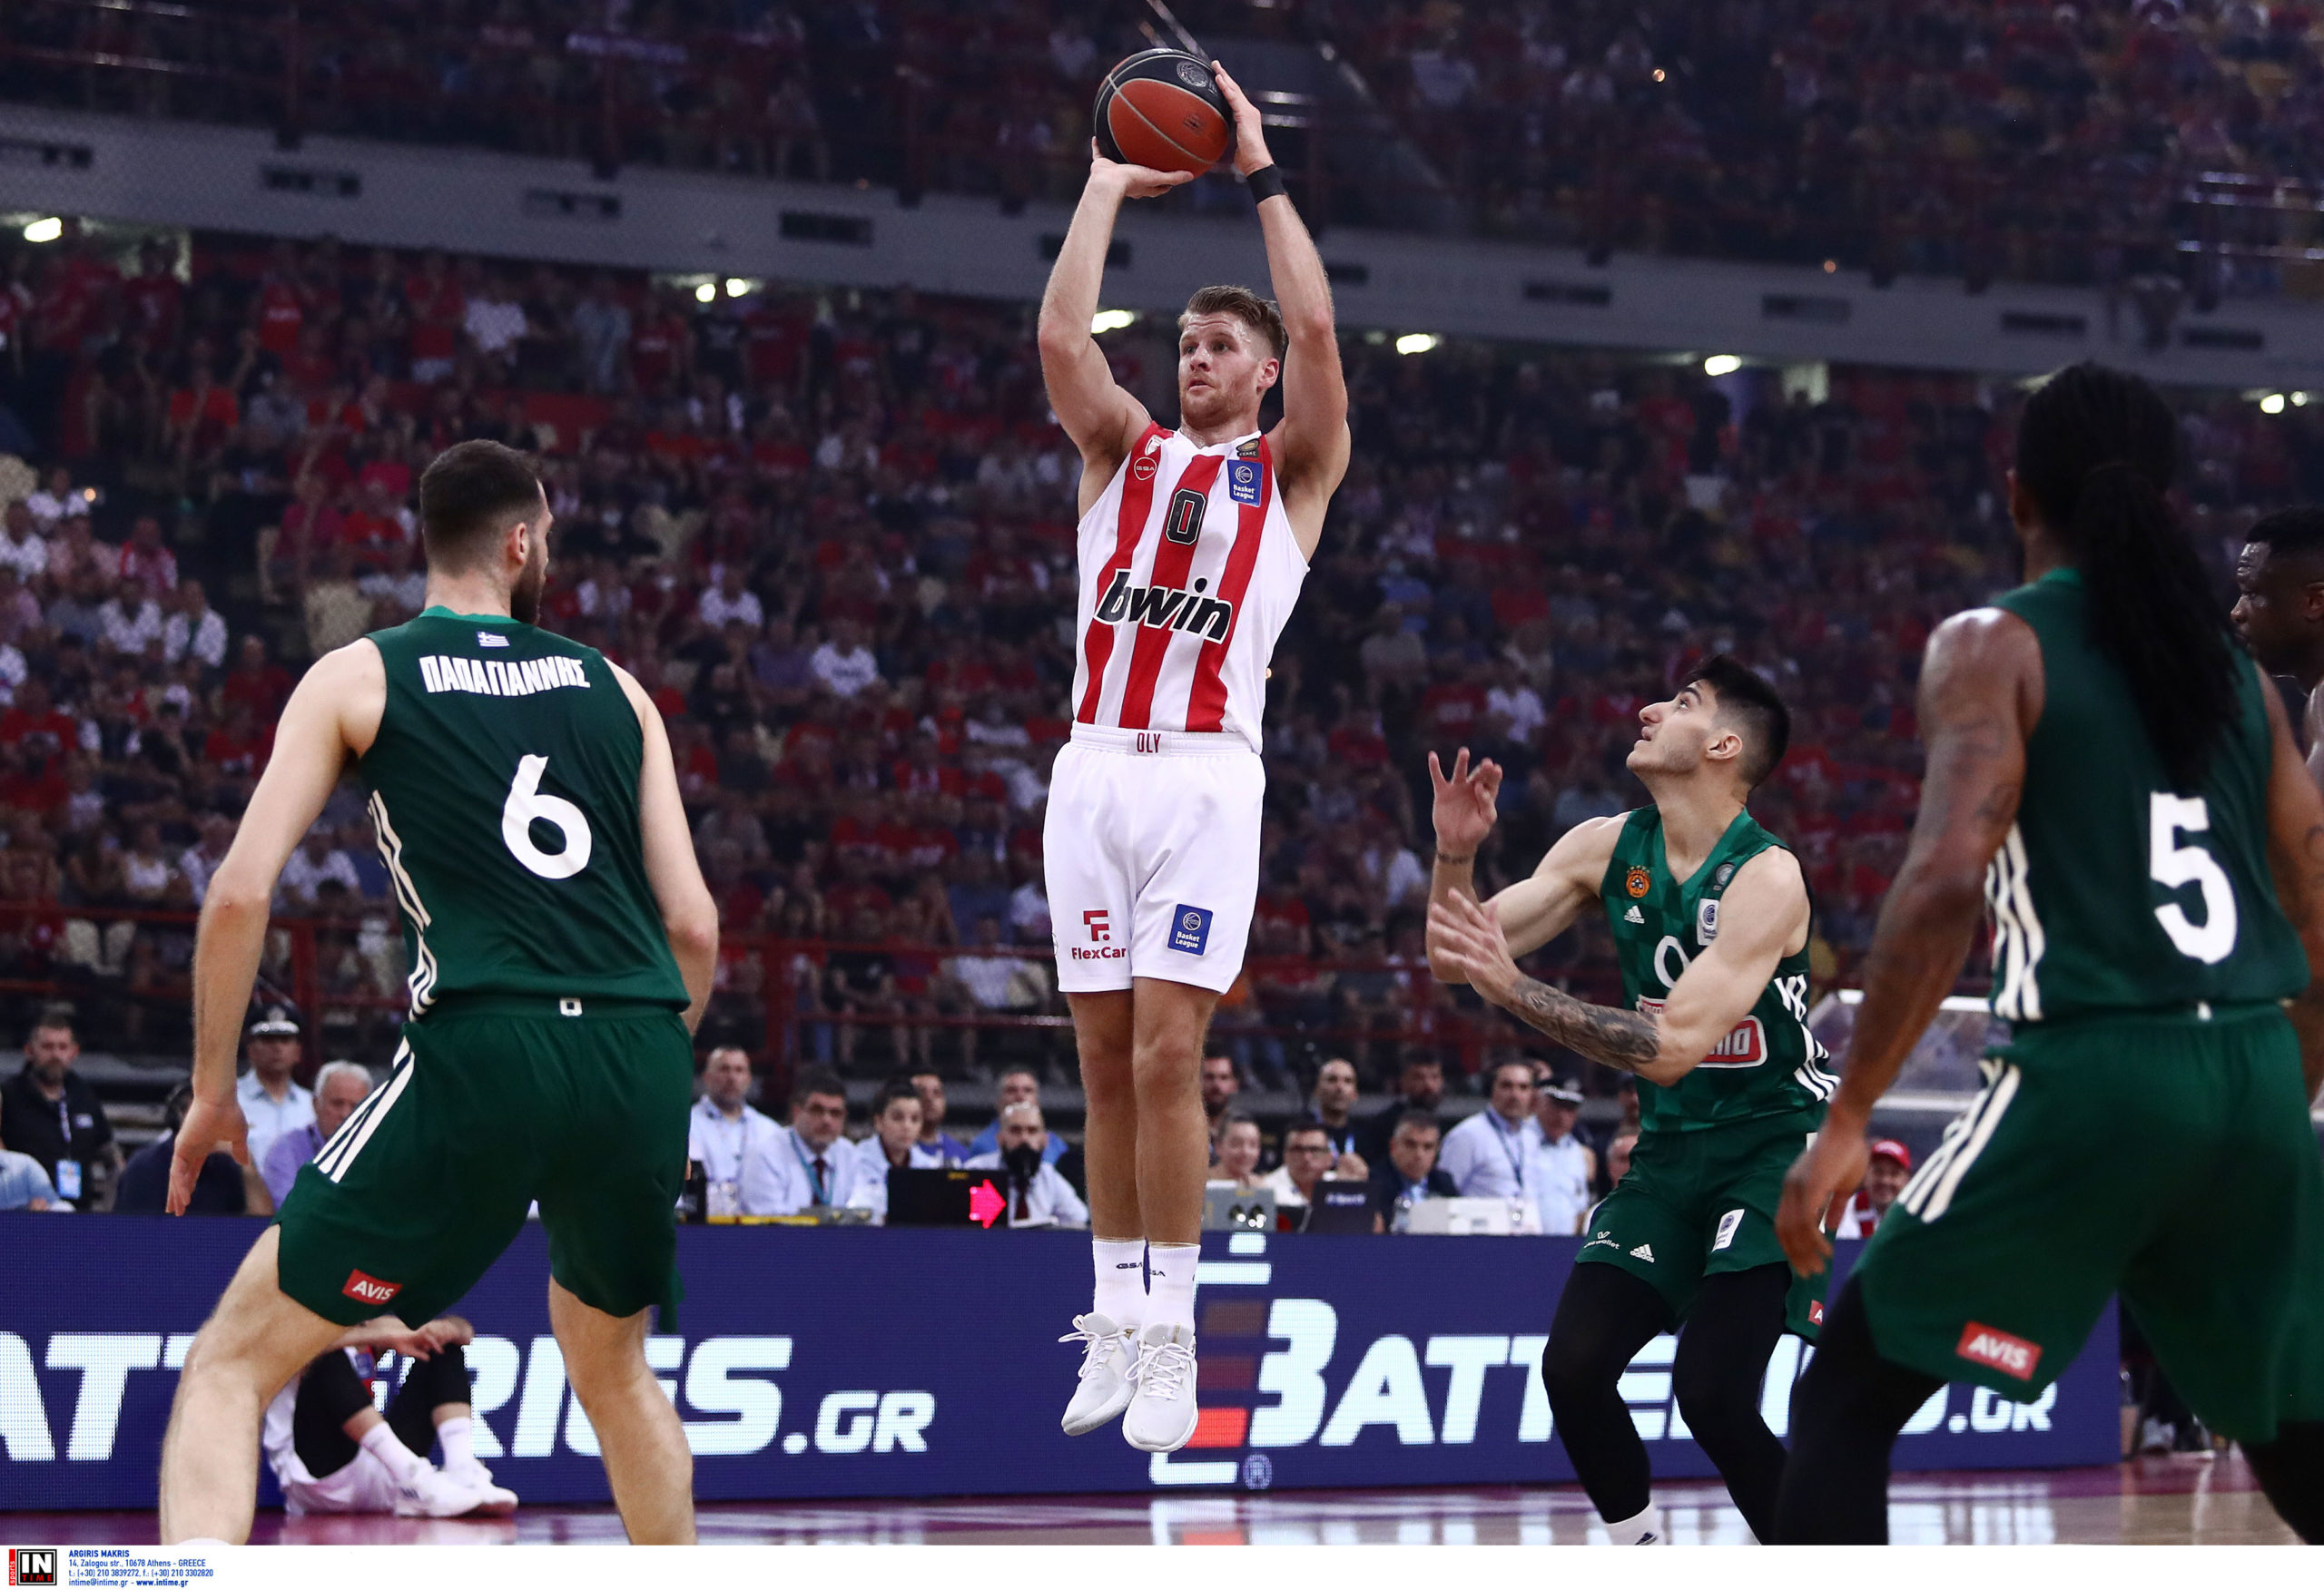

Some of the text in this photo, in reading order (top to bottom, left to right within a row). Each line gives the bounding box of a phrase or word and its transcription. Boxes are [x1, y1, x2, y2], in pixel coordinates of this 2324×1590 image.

[1233, 484, 1255, 494] Basket
[1233, 490, 1255, 500] League
[1165, 488, 1206, 545] 0
[1094, 568, 1233, 644] bwin
[419, 655, 591, 696] ΠΑΠΑΓΙΑΝΝΗΣ
[1137, 732, 1161, 753] OLY
[502, 753, 592, 879] 6
[2150, 790, 2237, 966] 5
[1175, 937, 1199, 948] League
[1177, 931, 1200, 942] Basket
[1071, 947, 1127, 960] FlexCar
[351, 1280, 395, 1300] AVIS
[1967, 1333, 2030, 1370] AVIS
